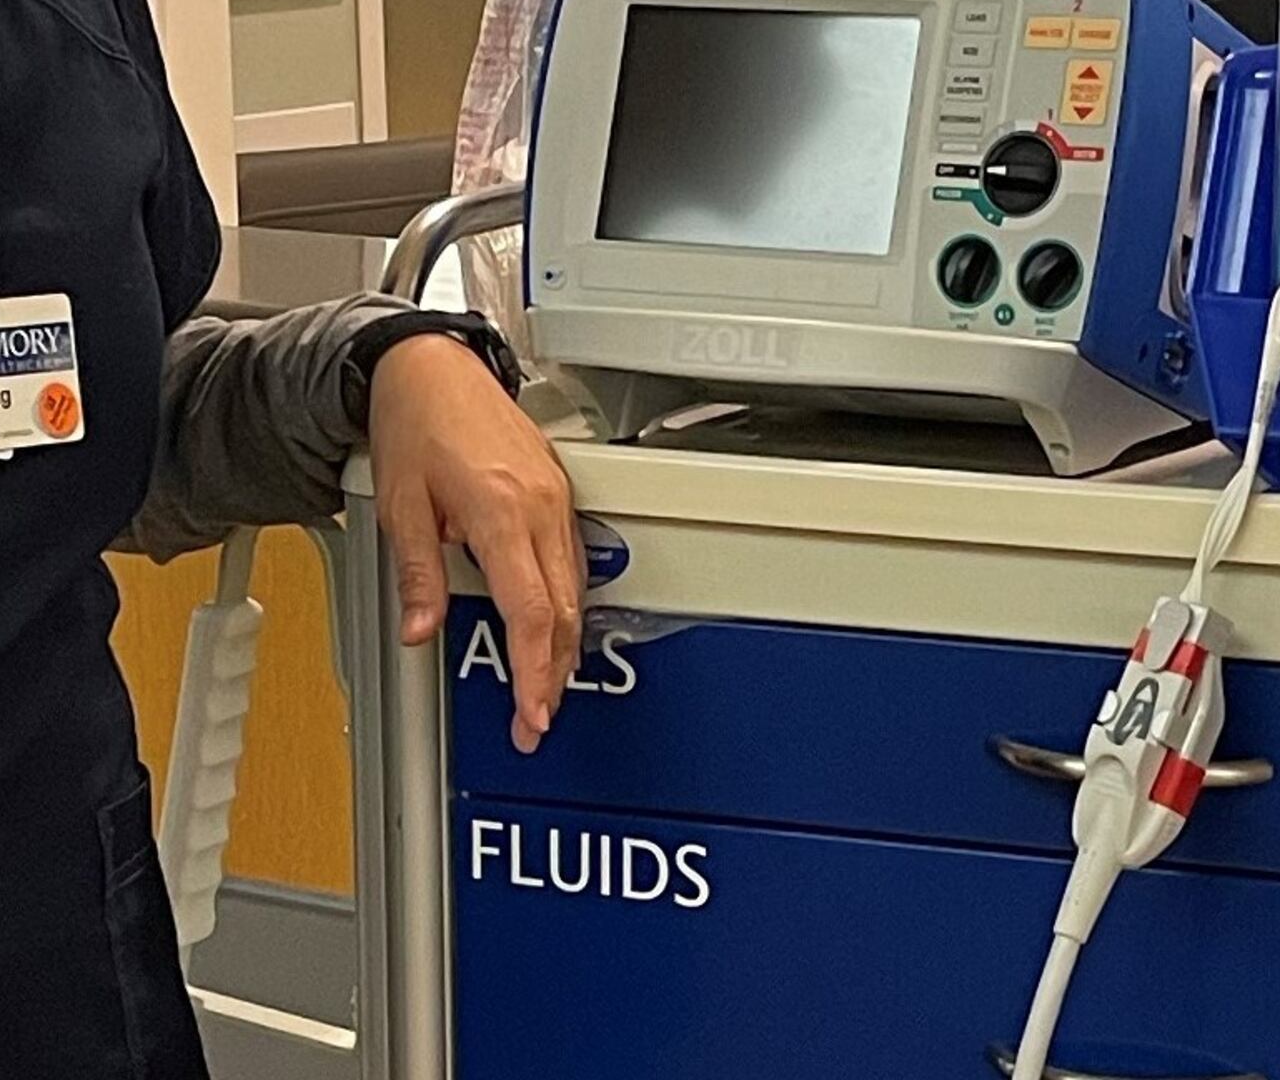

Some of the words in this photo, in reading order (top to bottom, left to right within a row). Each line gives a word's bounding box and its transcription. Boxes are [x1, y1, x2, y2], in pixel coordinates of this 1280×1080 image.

[1073, 0, 1083, 12] 2
[680, 324, 788, 366] ZOLL
[458, 619, 637, 695] ALS
[471, 818, 711, 908] FLUIDS
